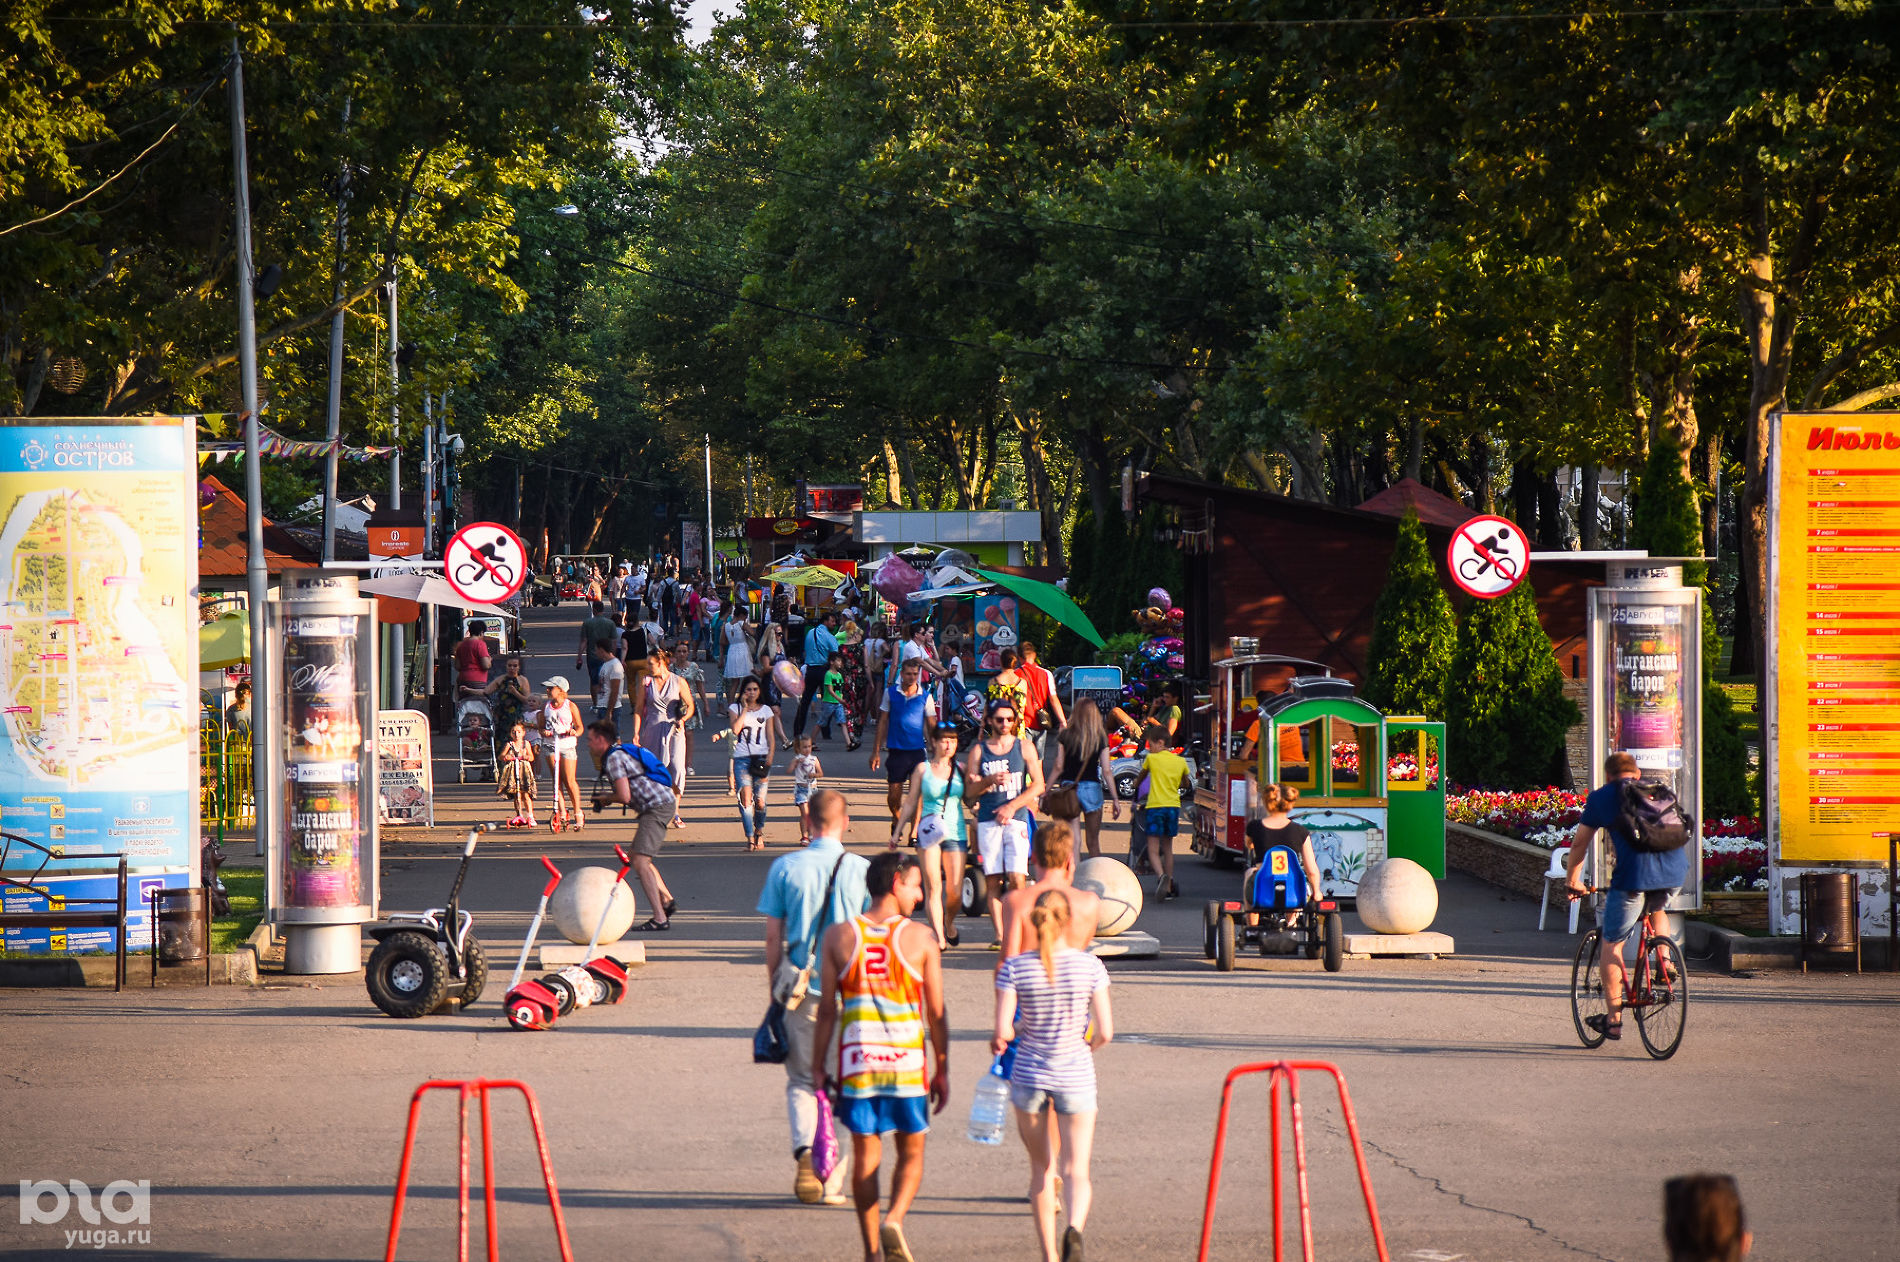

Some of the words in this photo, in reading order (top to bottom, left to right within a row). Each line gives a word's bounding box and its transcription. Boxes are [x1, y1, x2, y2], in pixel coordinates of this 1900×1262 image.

[1807, 427, 1900, 450] Июль
[53, 451, 134, 470] ОСТРОВ
[1613, 608, 1626, 622] 25
[287, 619, 299, 633] 23
[286, 767, 298, 780] 25
[1275, 855, 1286, 871] 3
[865, 946, 889, 976] 2
